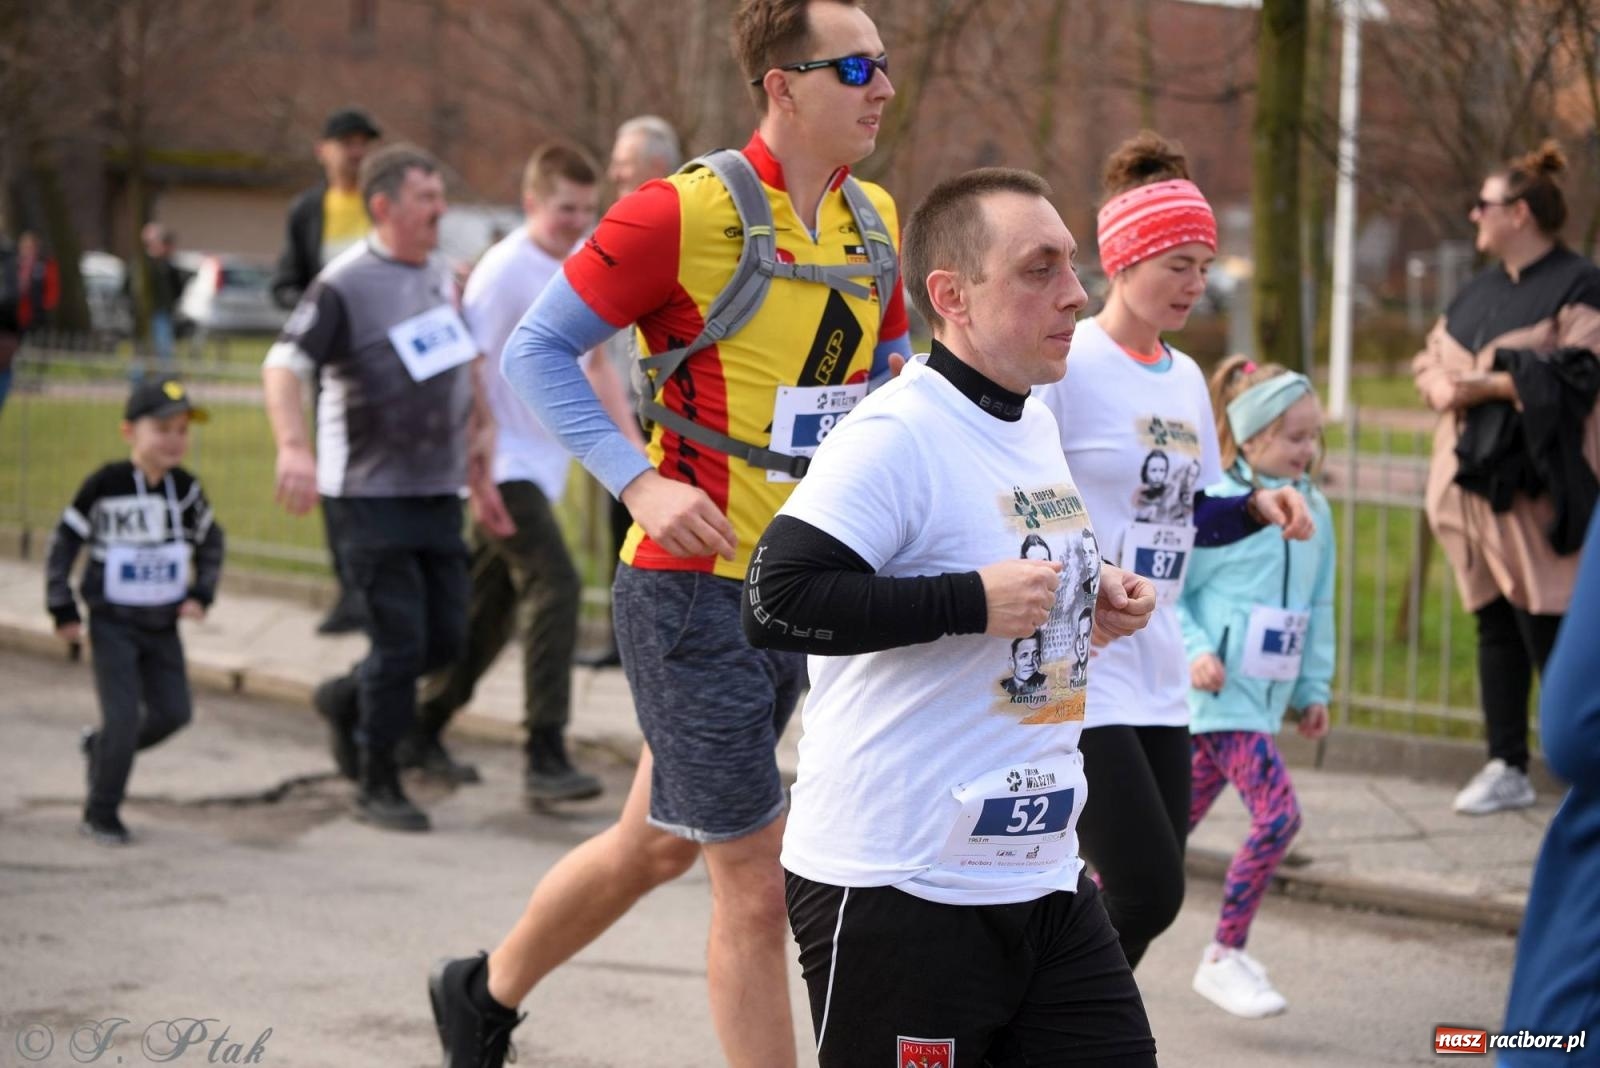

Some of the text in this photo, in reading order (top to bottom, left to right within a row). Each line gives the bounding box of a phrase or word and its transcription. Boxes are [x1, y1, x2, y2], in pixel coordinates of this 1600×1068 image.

[815, 329, 844, 385] RP
[1031, 488, 1057, 502] TROPEM
[1037, 495, 1083, 520] WILCZYM
[1151, 551, 1177, 578] 87
[749, 545, 834, 641] BRUBECK
[1010, 694, 1047, 707] Kontrym
[1005, 796, 1049, 833] 52
[903, 1043, 948, 1055] POLSKA
